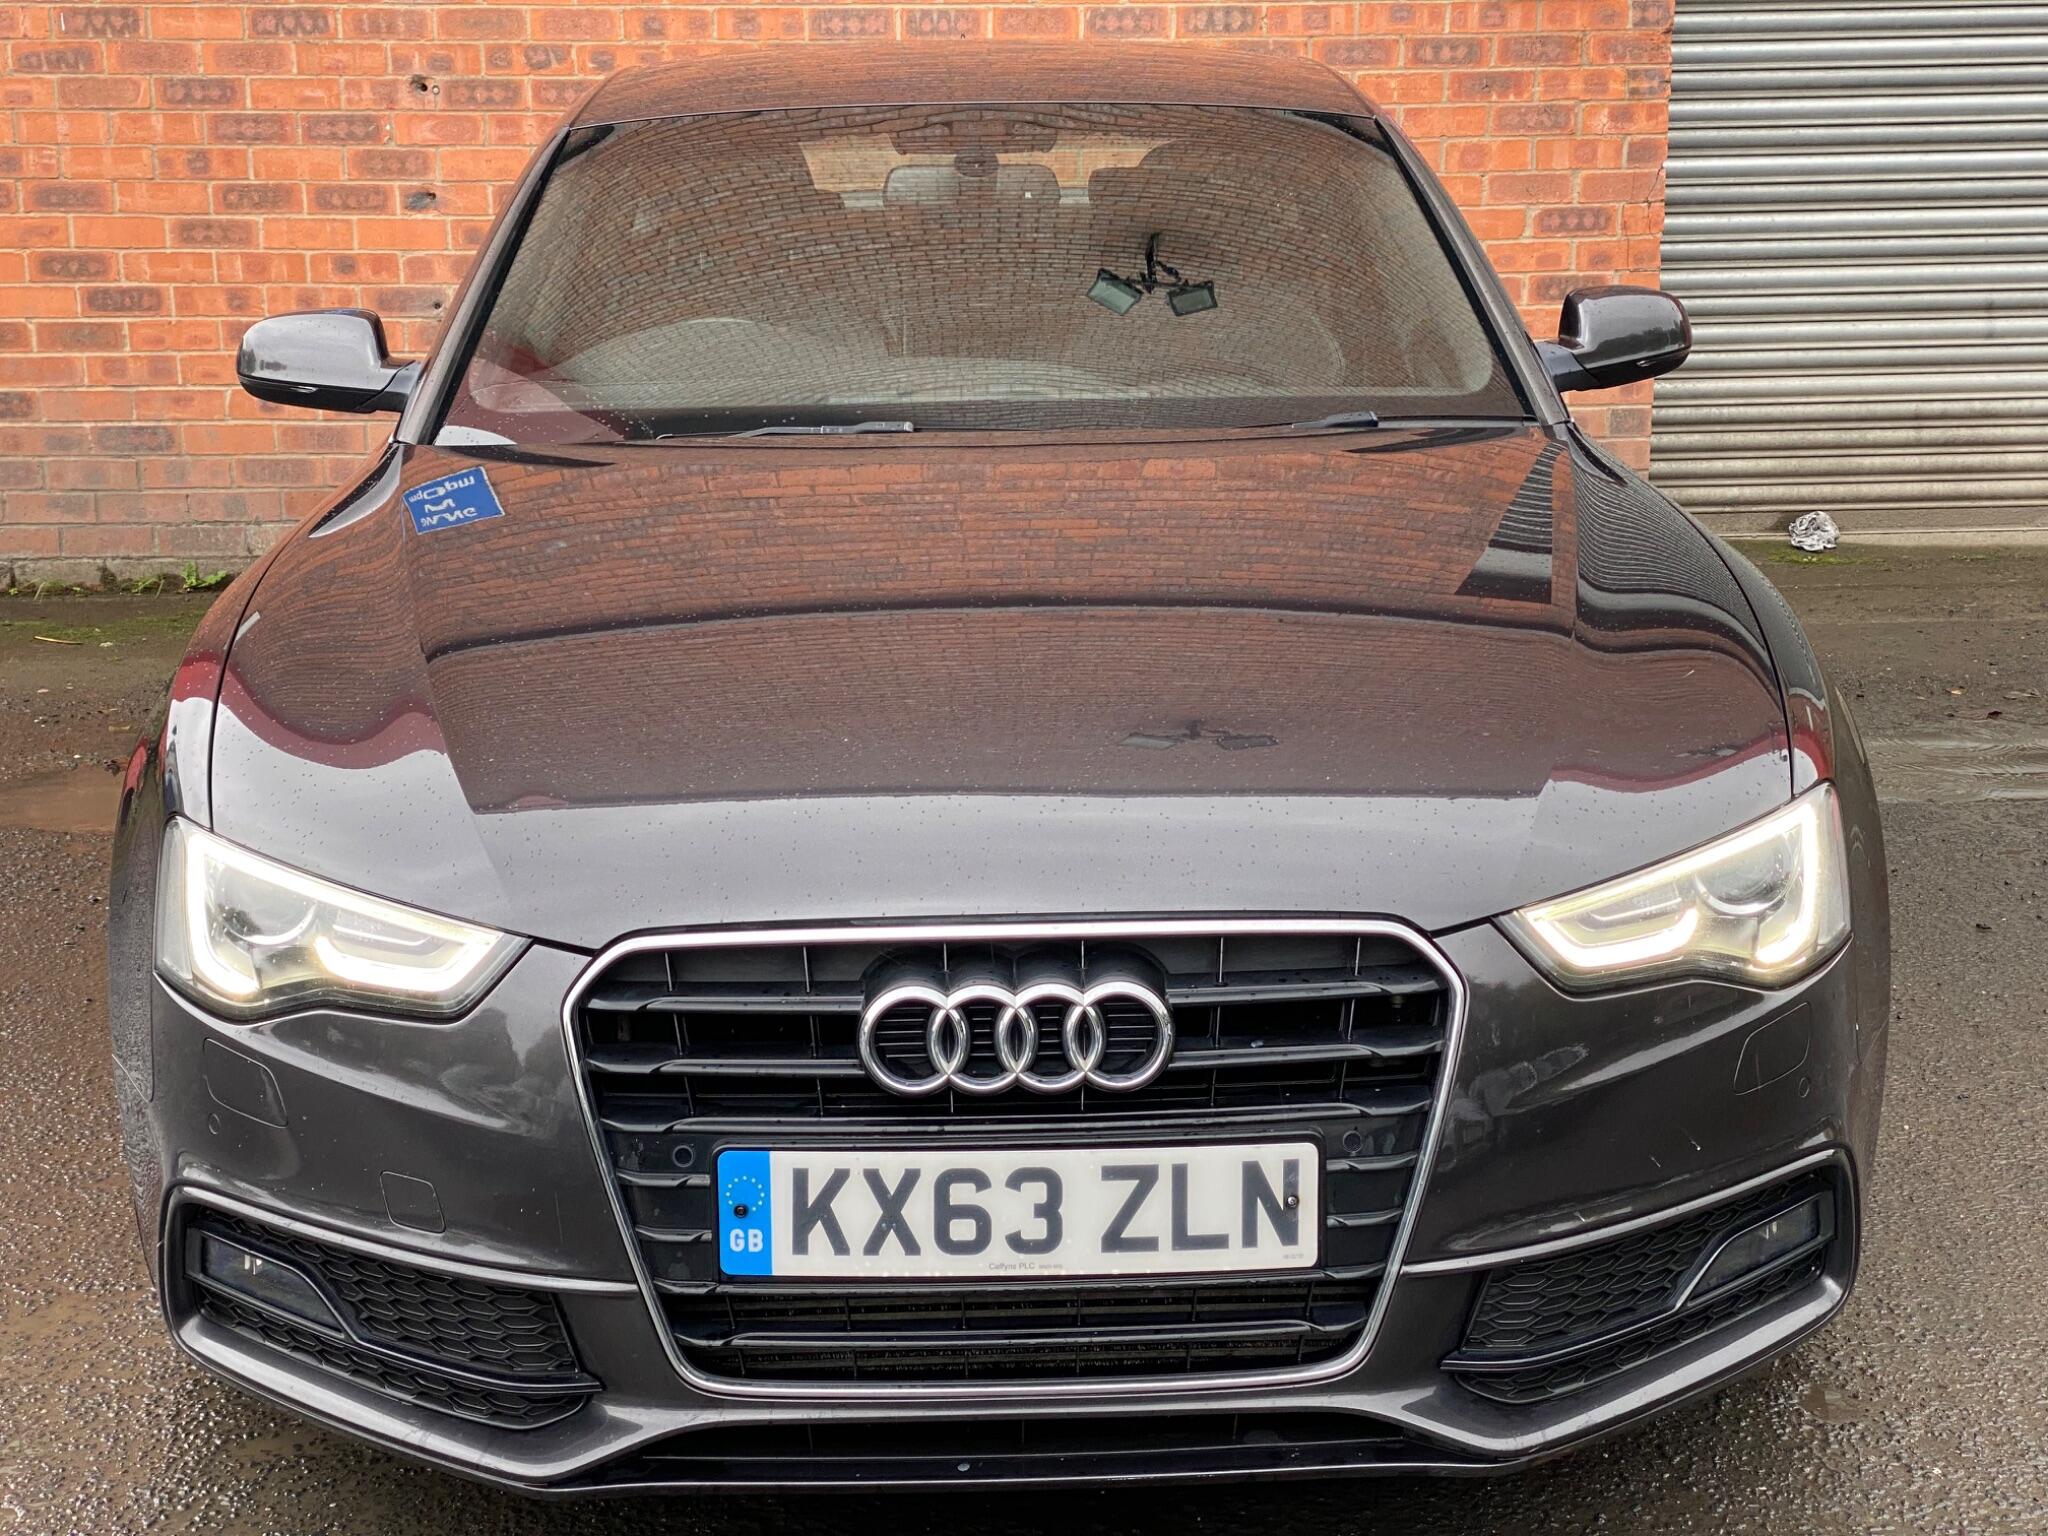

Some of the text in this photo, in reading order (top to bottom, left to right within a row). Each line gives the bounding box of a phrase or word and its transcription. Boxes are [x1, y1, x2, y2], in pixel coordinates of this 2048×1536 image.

[792, 1159, 1300, 1256] KX63 ZLN
[730, 1229, 763, 1252] GB
[1019, 1262, 1035, 1270] PLC
